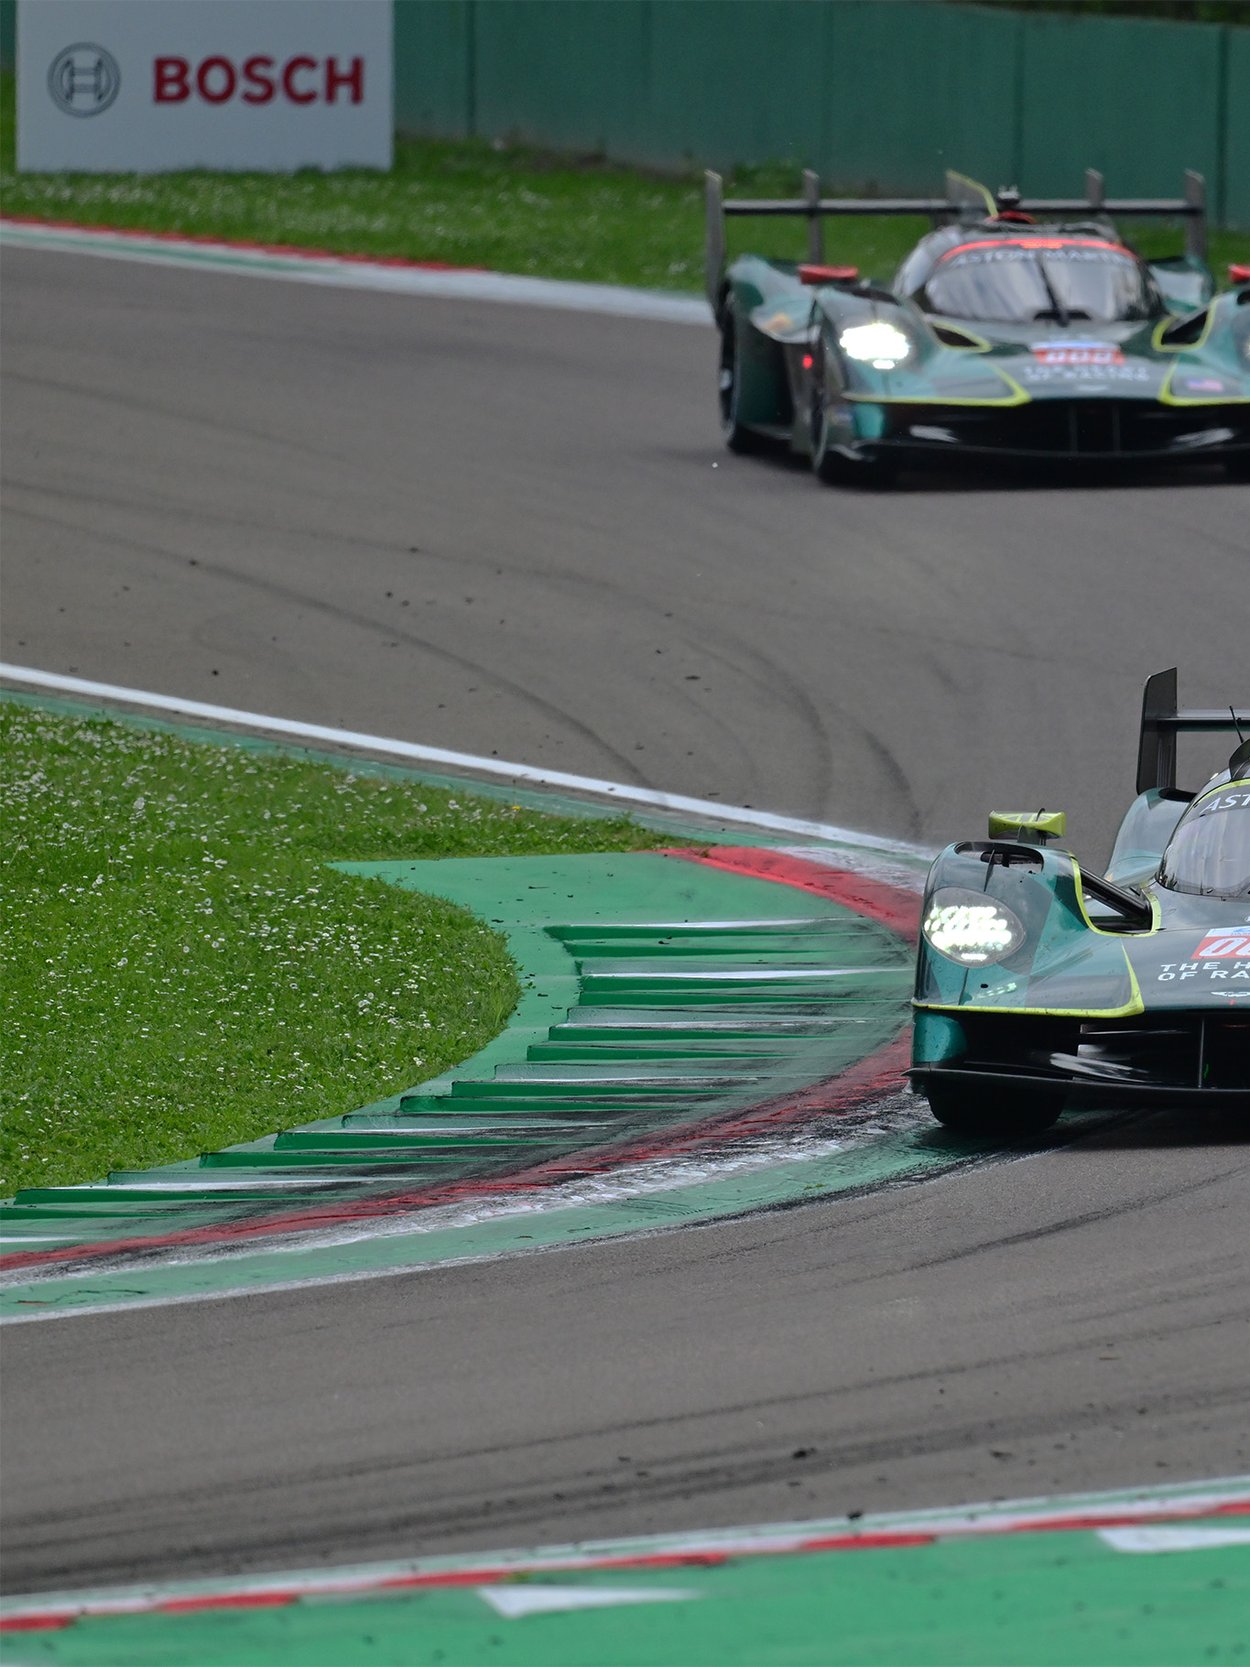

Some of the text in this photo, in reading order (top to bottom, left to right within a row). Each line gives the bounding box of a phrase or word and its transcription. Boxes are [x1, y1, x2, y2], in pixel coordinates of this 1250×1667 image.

[153, 56, 365, 105] BOSCH
[1160, 961, 1221, 972] THE
[1158, 970, 1198, 982] OF
